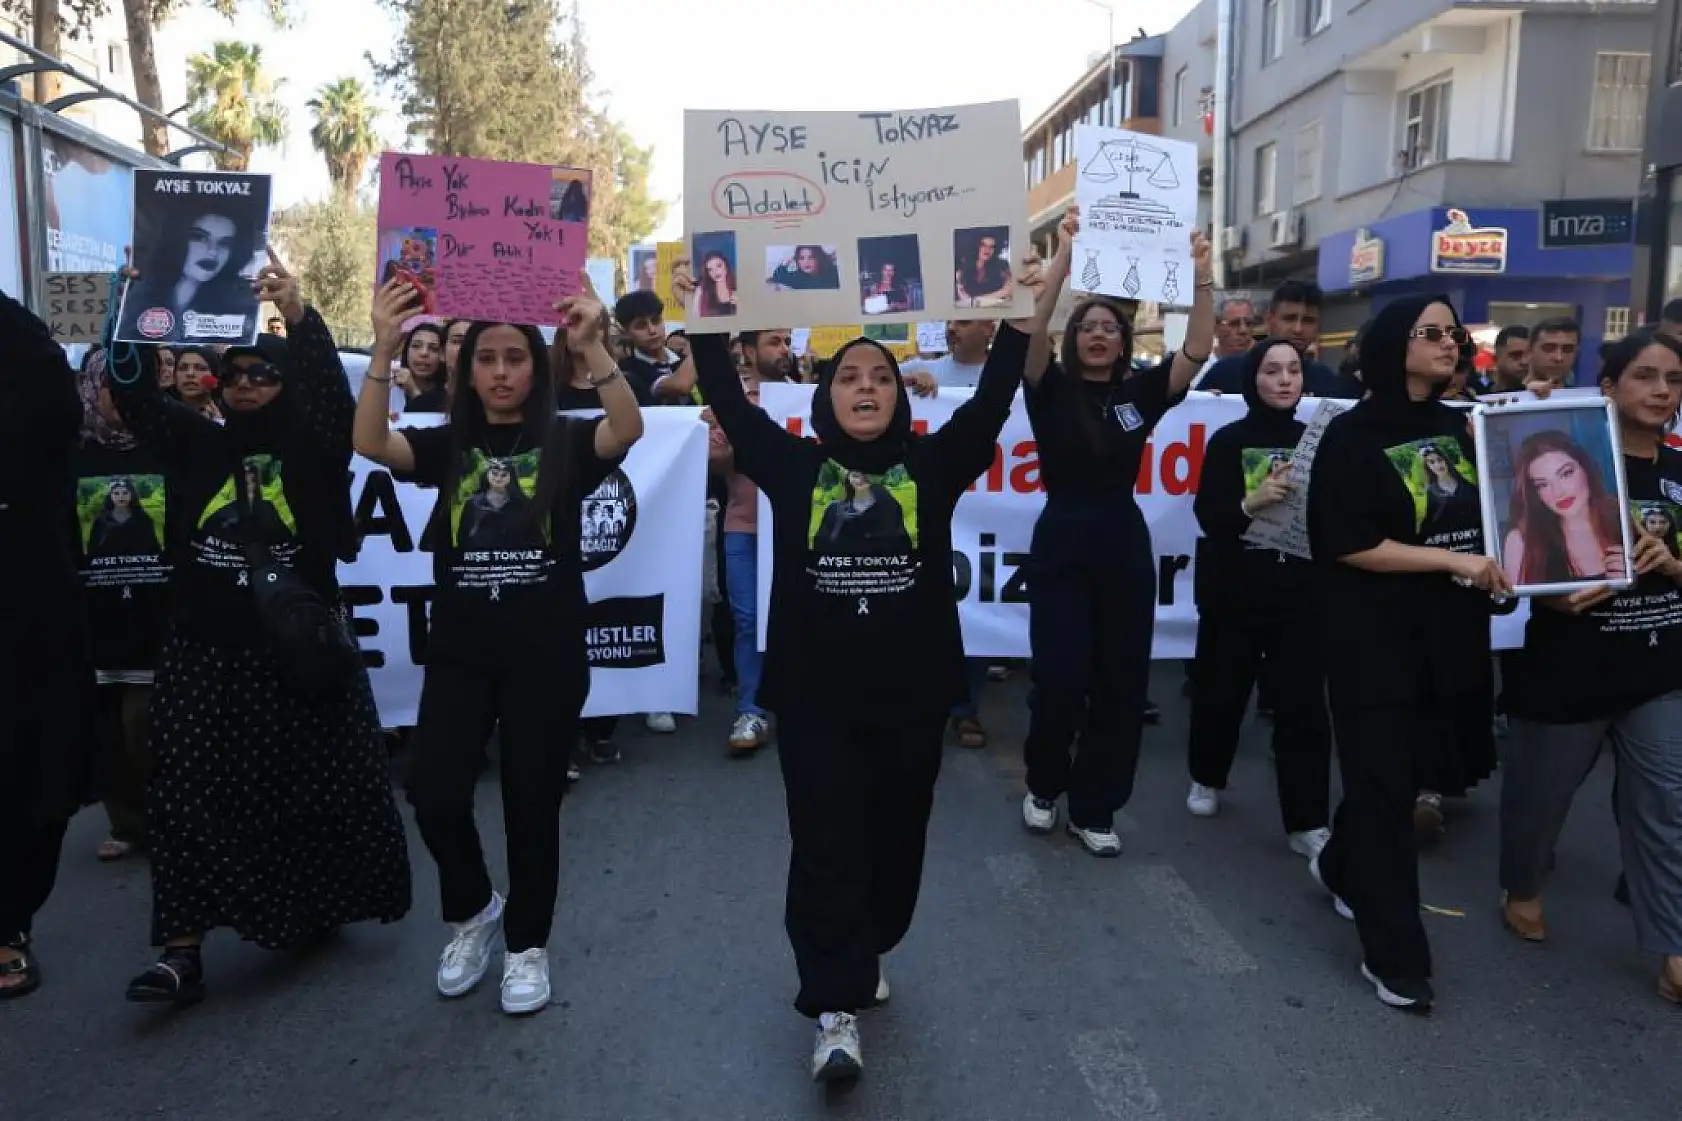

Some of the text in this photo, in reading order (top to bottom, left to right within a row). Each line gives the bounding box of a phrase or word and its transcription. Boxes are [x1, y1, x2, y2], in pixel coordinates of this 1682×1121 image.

[717, 118, 807, 156] AYŞE
[154, 179, 252, 195] AYŞE TOKYAZ
[442, 162, 470, 192] Yok
[723, 183, 813, 216] Adalet
[1549, 213, 1605, 238] imza
[47, 275, 97, 294] SES
[463, 550, 543, 562] AYŞE TOKYAZ
[819, 555, 908, 568] AYŞE TOKYAZ
